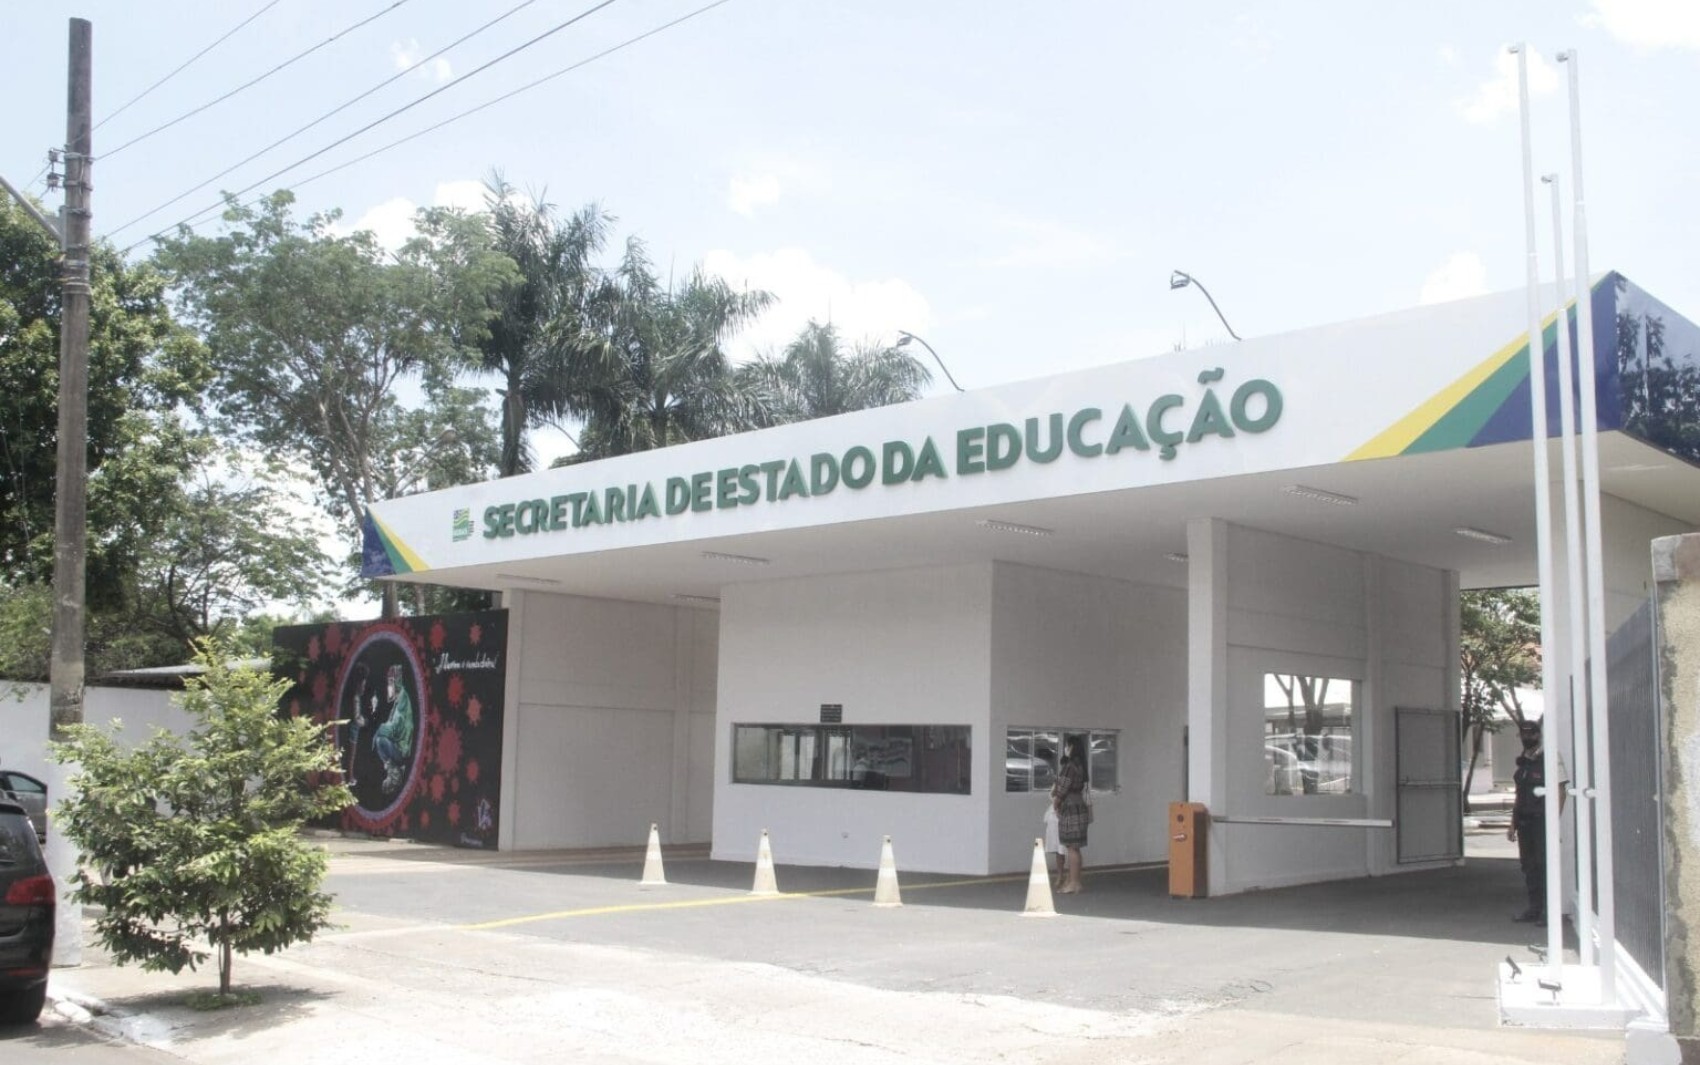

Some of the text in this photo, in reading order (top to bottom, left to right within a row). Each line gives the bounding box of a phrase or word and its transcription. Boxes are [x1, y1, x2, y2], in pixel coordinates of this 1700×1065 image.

[483, 367, 1284, 539] SECRETARIA DE ESTADO DA EDUCAÇÃO
